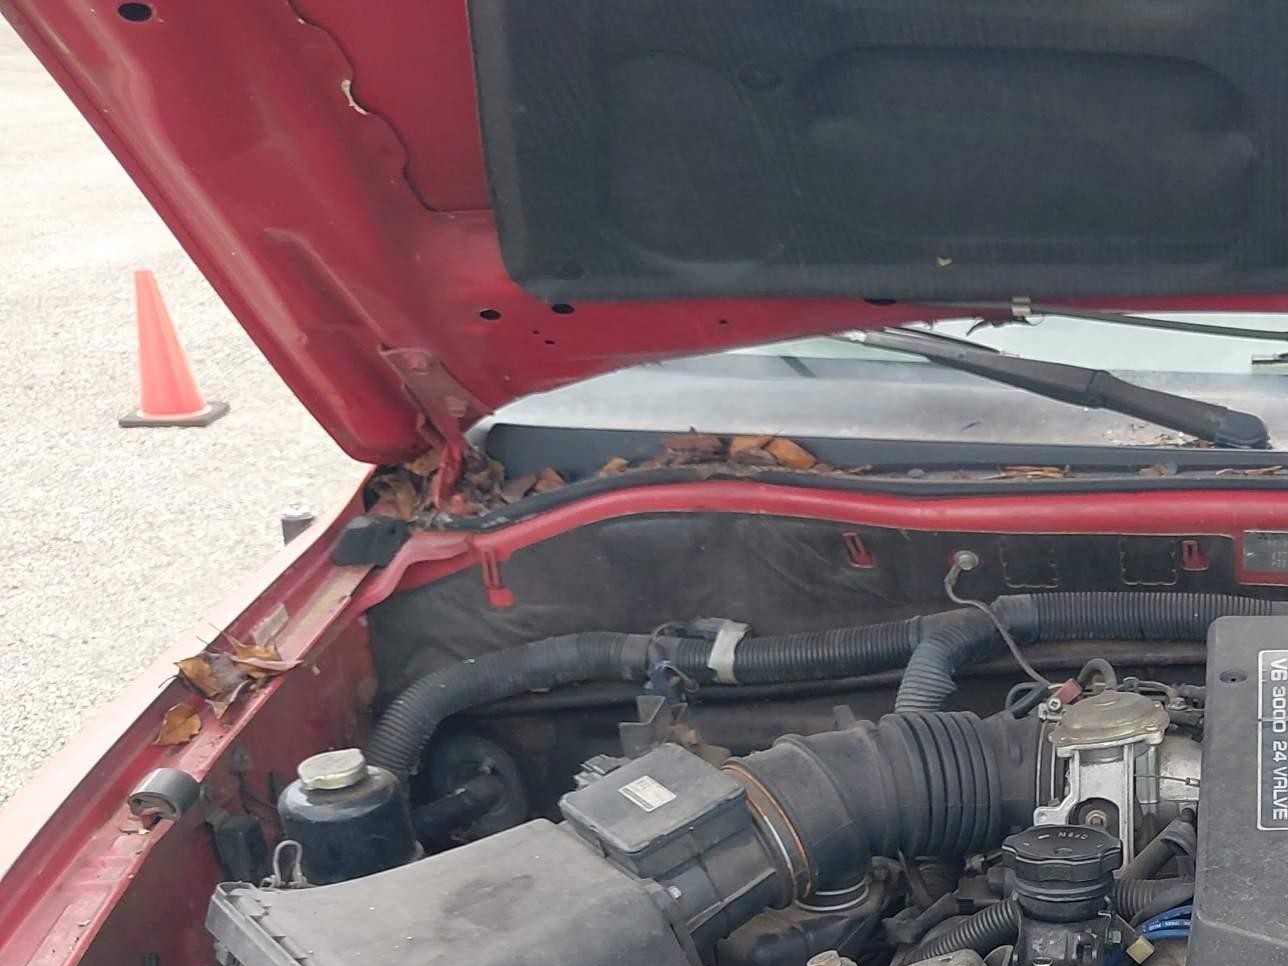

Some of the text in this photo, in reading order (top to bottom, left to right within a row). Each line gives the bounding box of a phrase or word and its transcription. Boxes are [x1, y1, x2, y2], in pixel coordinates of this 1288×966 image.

[1270, 658, 1288, 820] V6 3000 24 VALVE
